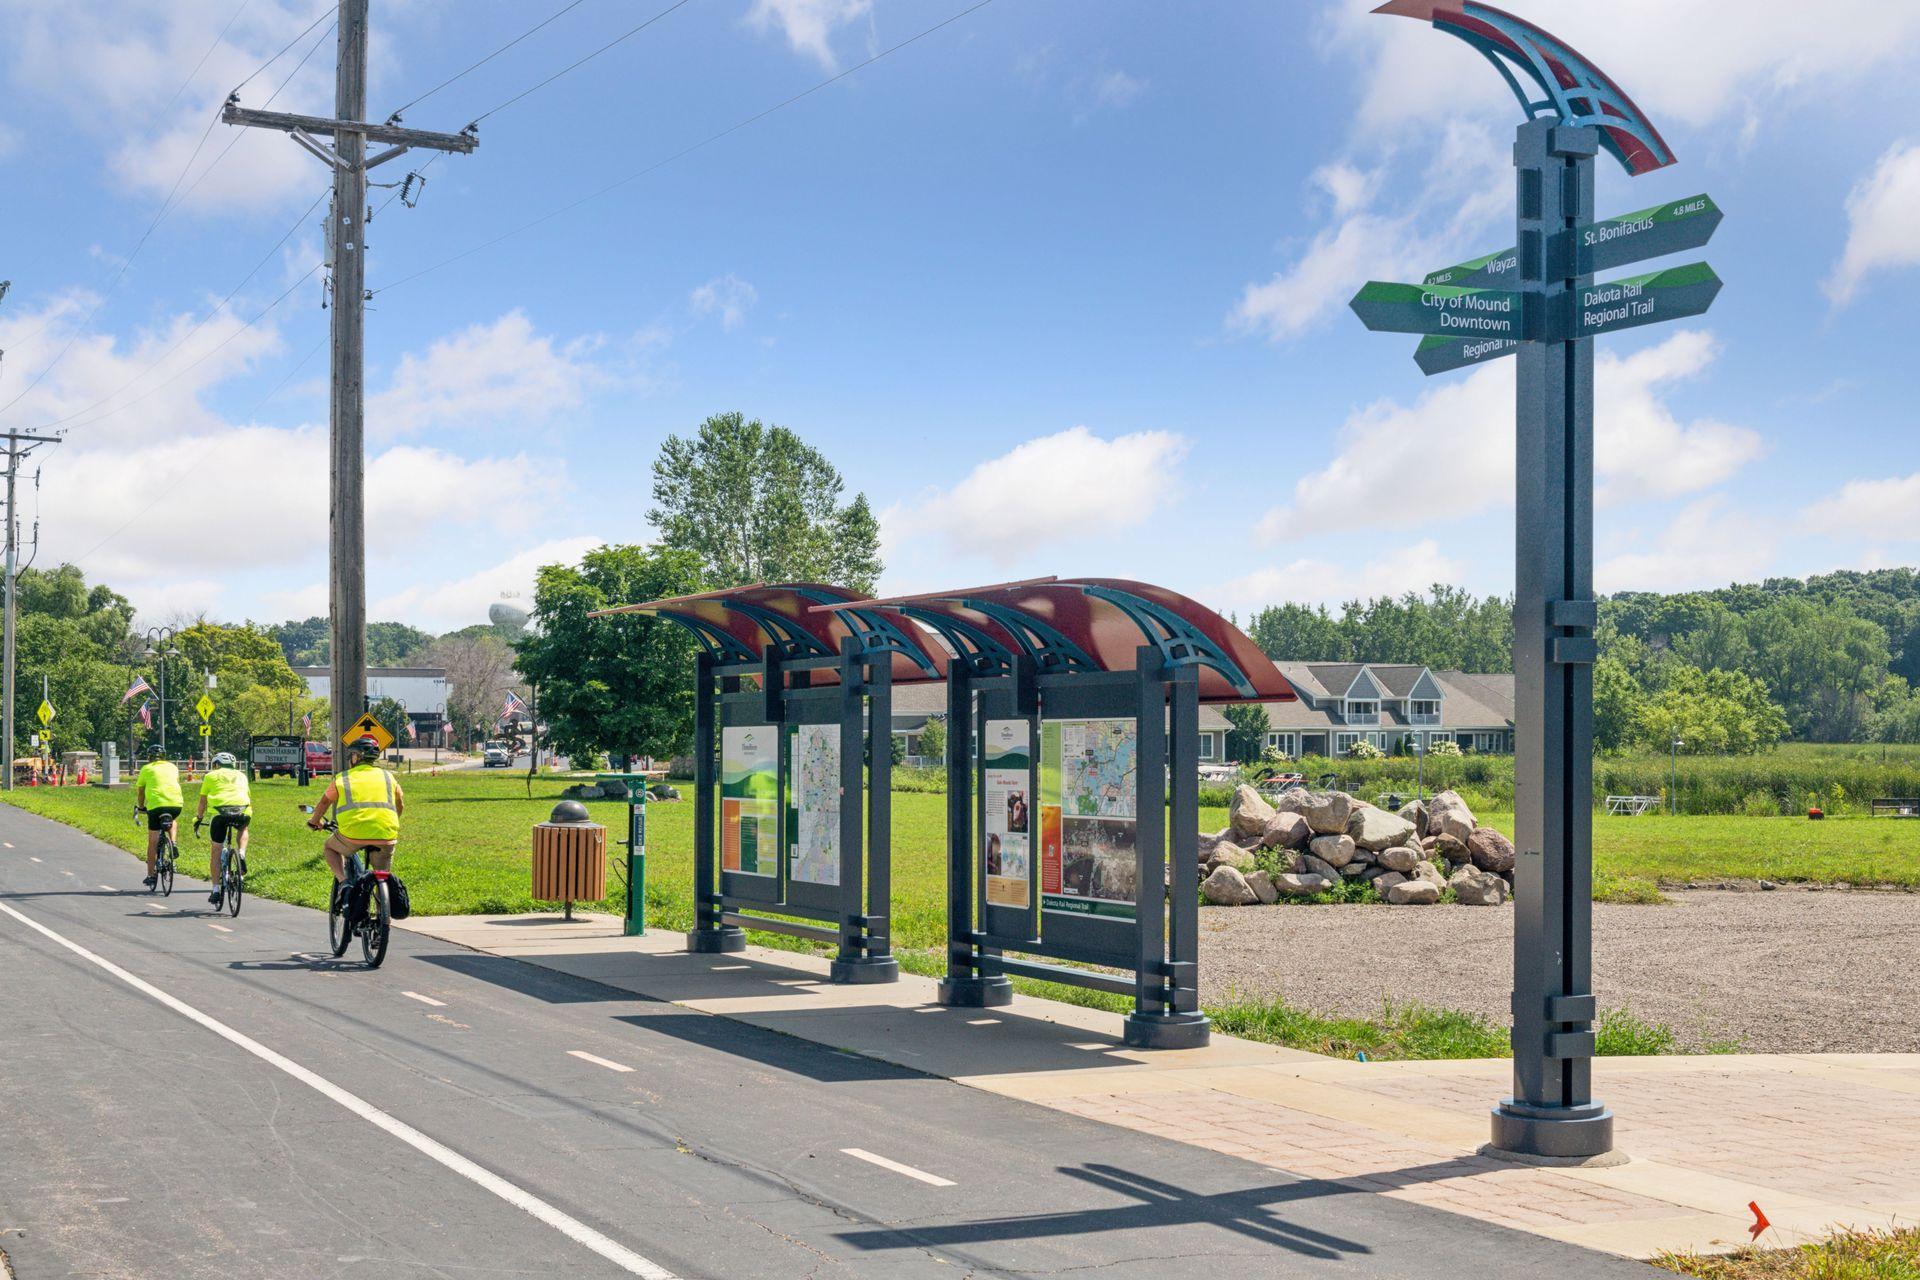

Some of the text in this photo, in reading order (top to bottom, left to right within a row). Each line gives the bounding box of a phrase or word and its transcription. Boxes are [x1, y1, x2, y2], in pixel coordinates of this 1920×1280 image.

[1673, 199, 1706, 216] 4.8 MILES
[1584, 216, 1655, 247] St. Bonifacius
[1436, 271, 1452, 284] MILES
[1421, 291, 1510, 312] City of Mound
[1584, 280, 1642, 307] Dakota Rail
[1440, 312, 1511, 331] Downtown
[1584, 297, 1654, 327] Regional Trail
[1463, 339, 1503, 359] Regional
